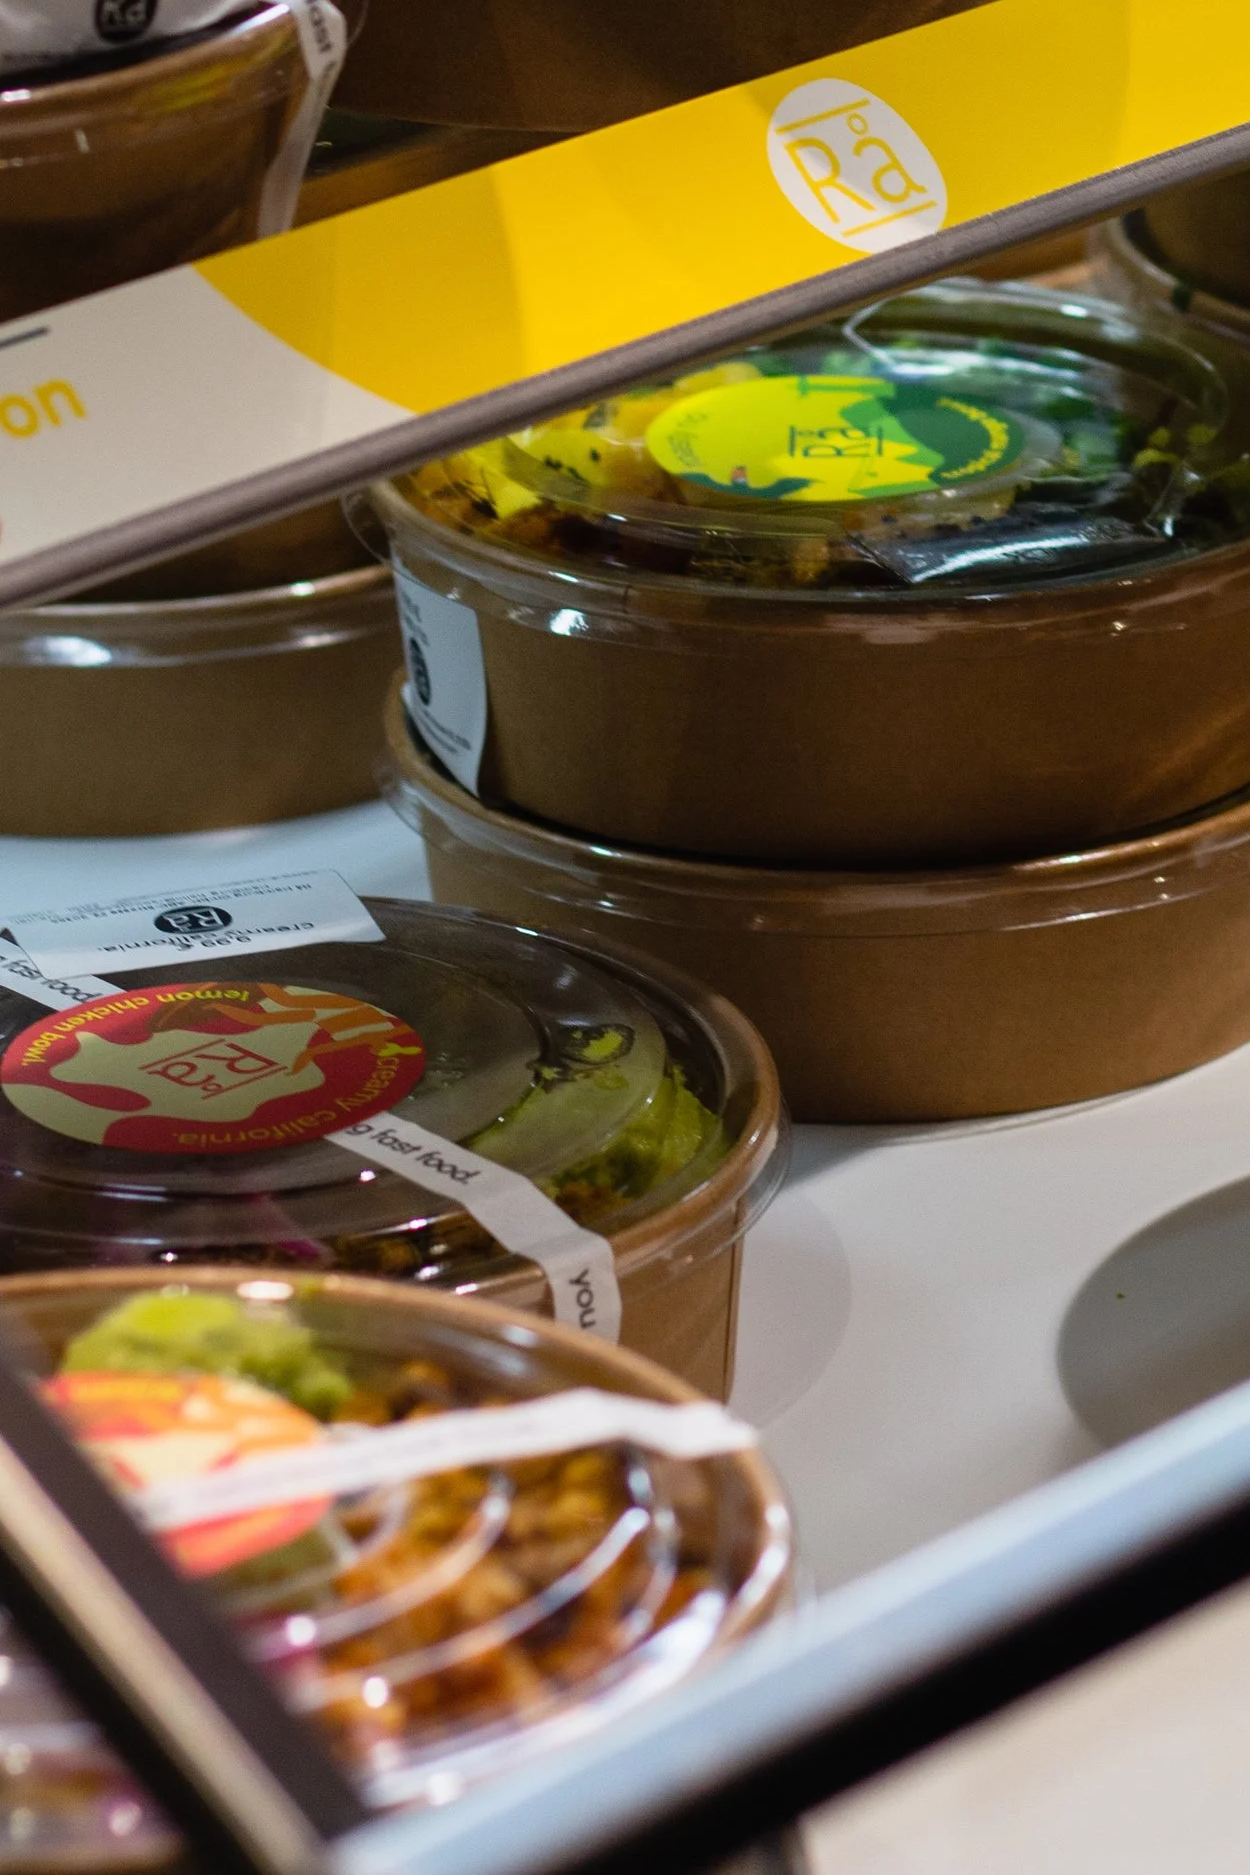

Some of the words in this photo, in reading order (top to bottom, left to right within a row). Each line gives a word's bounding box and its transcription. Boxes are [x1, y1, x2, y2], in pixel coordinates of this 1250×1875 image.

[783, 112, 929, 224] Rå
[224, 921, 315, 938] creamy
[54, 995, 151, 1032] chicken
[156, 988, 250, 1003] lemon
[147, 1042, 282, 1094] Rå
[334, 1056, 401, 1114] creamy
[170, 1109, 338, 1148] california.
[370, 1127, 422, 1156] fast
[413, 1151, 481, 1186] food.
[568, 1267, 597, 1330] you
